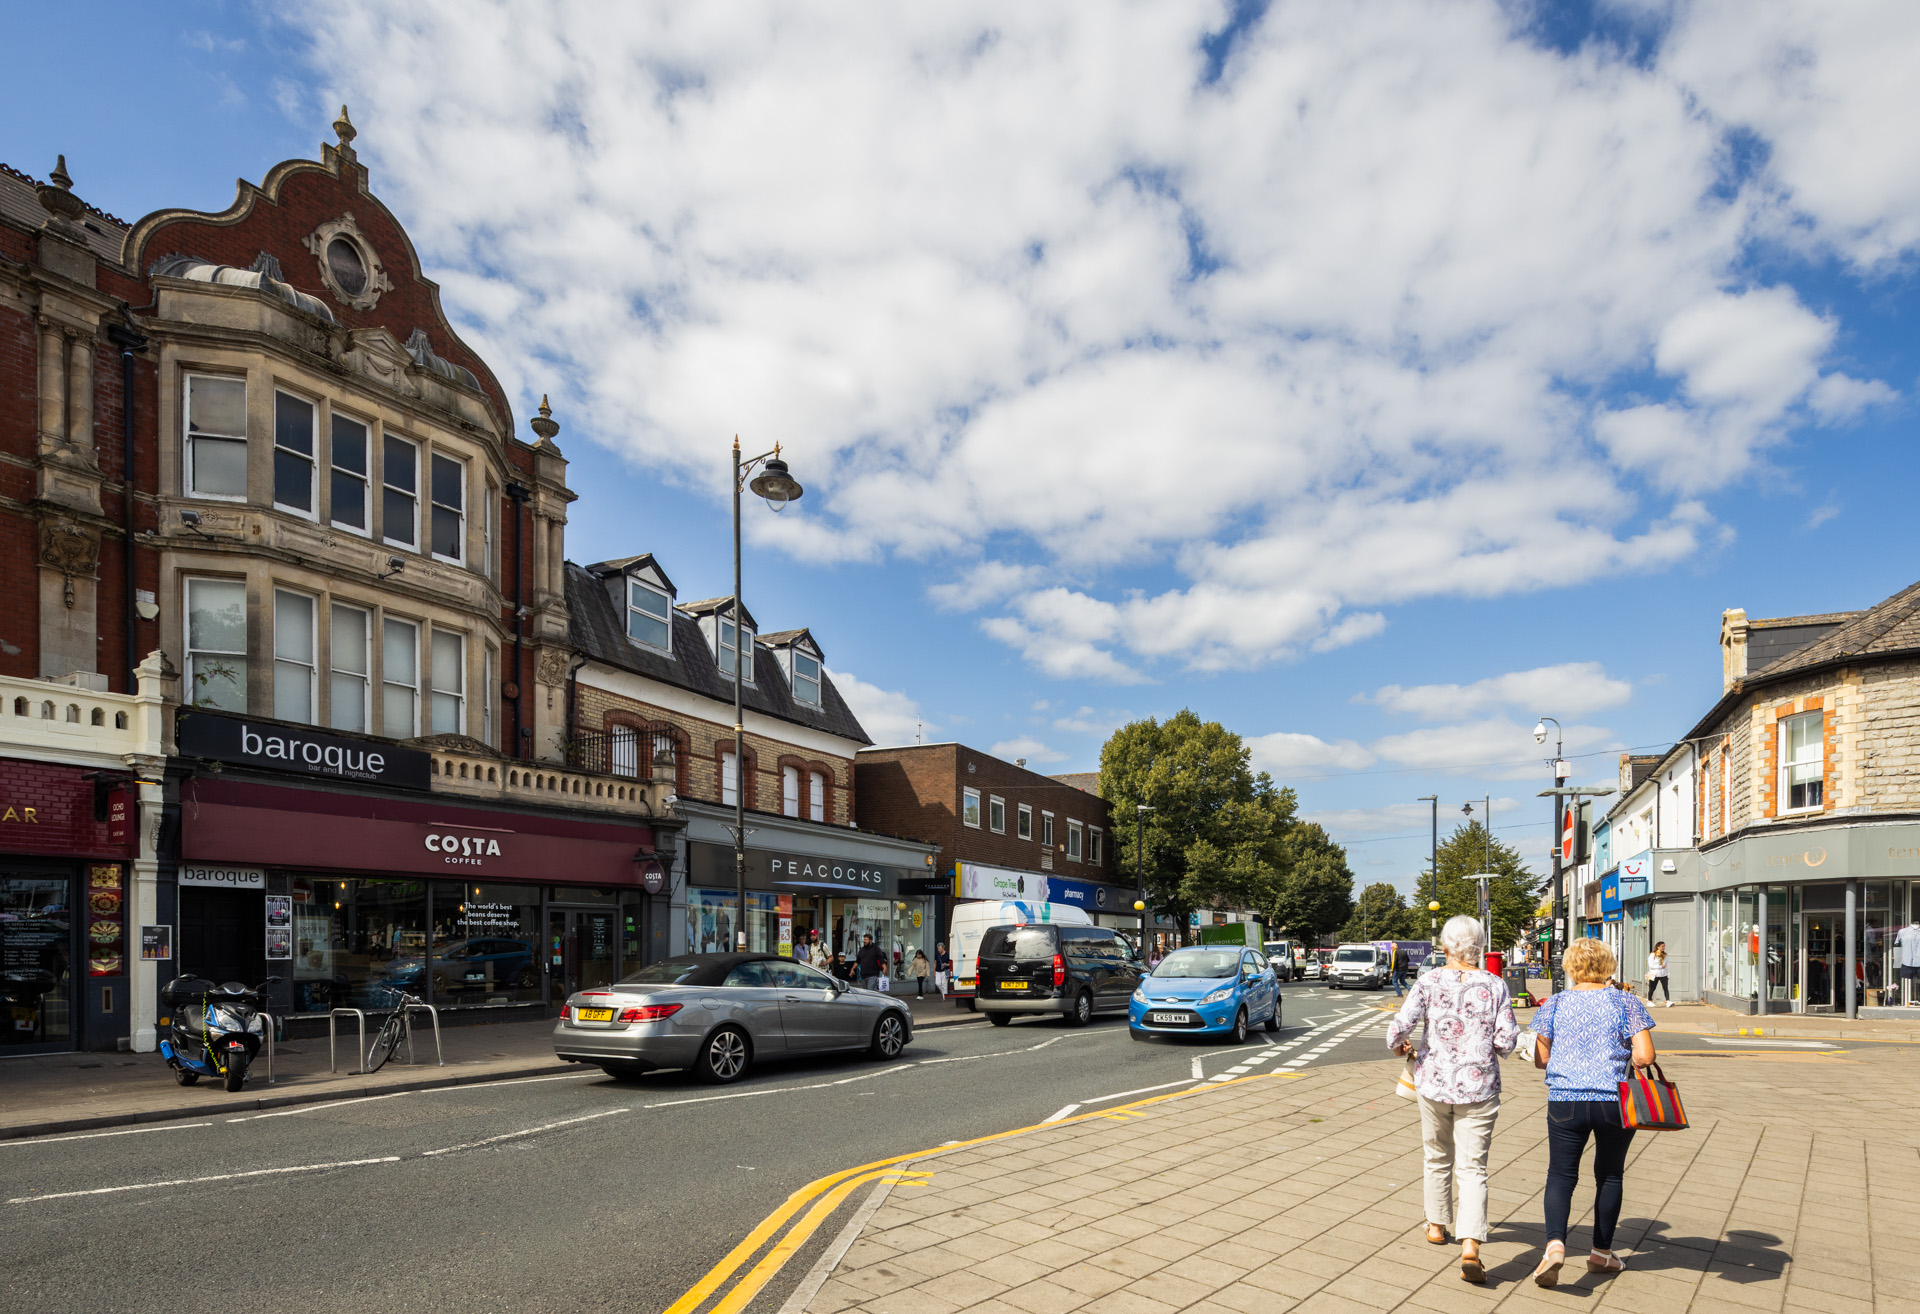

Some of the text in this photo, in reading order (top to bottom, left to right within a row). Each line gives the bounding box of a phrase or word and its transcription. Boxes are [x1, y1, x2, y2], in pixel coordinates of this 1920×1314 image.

[242, 725, 385, 774] baroque
[323, 765, 336, 774] and
[344, 770, 376, 780] nightclub
[112, 803, 124, 811] OCHO
[112, 813, 125, 822] LOUNGE
[425, 834, 501, 856] COSTA
[445, 857, 482, 866] COFFEE
[184, 866, 260, 886] baroque
[772, 860, 882, 884] PEACOCKS
[994, 877, 1016, 890] Grape Tree
[1064, 888, 1084, 900] pharmacy
[584, 1010, 606, 1018] A8 GFF
